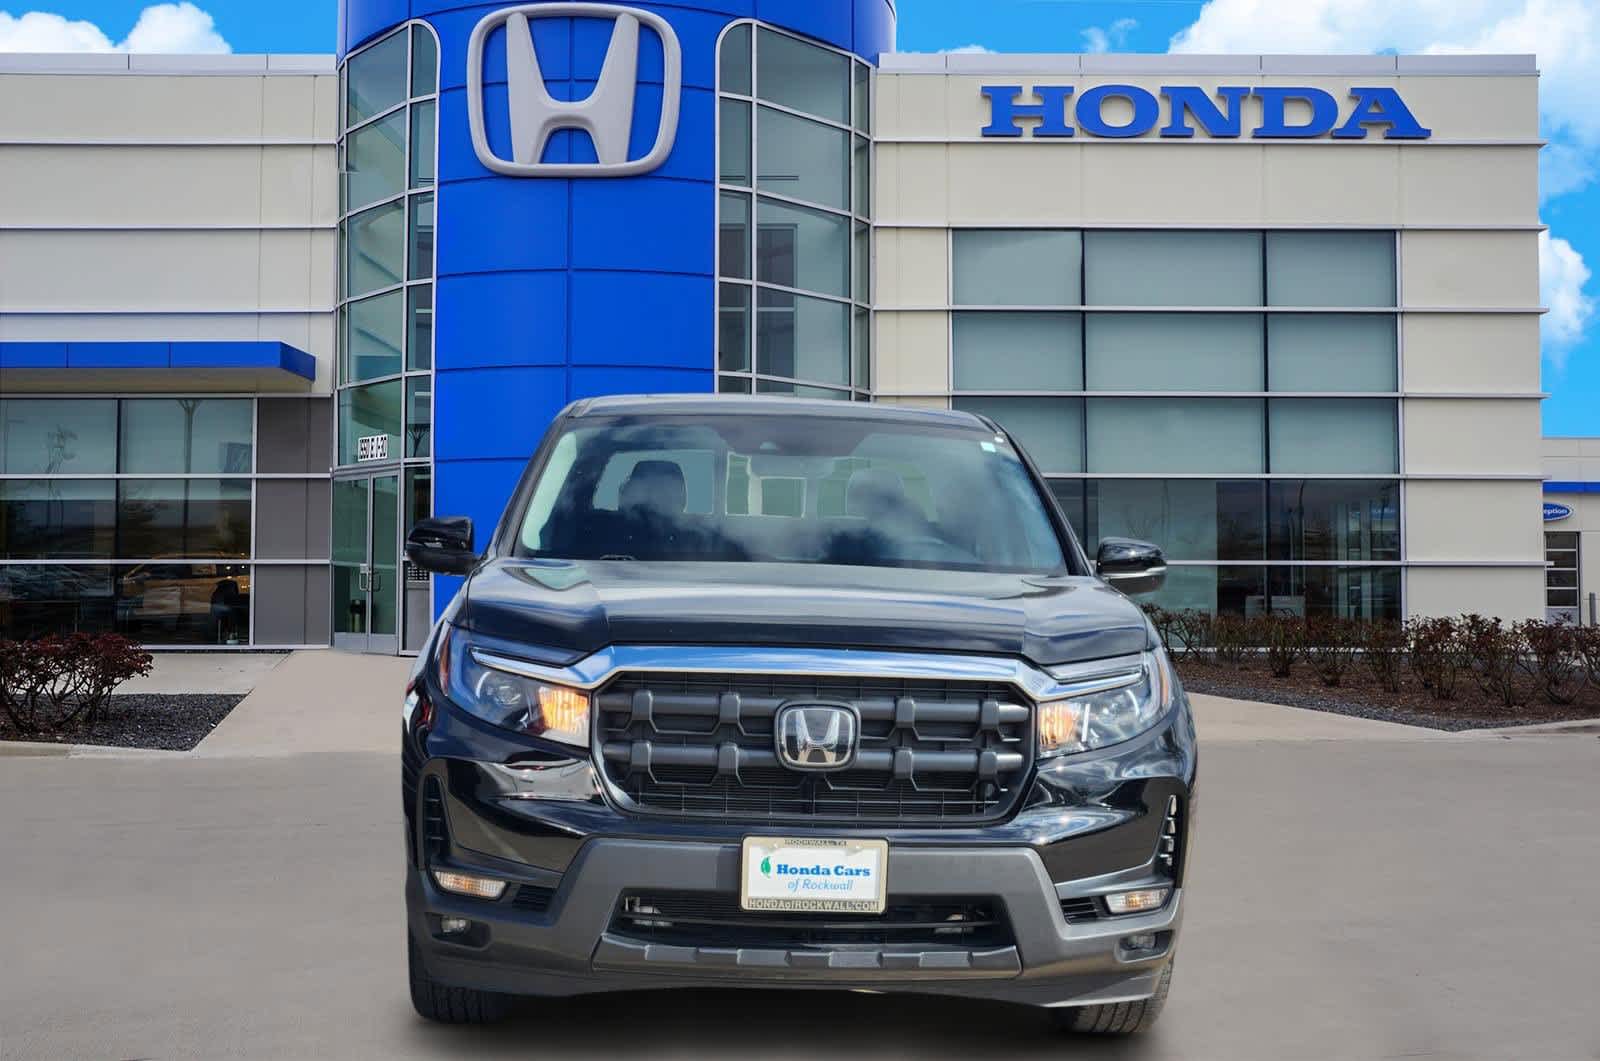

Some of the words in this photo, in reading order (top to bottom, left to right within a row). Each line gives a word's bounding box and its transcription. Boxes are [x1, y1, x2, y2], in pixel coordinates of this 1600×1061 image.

[981, 84, 1432, 139] HONDA
[776, 863, 831, 876] Honda
[833, 865, 871, 877] Cars
[787, 878, 799, 892] of
[802, 879, 853, 891] Rockwall
